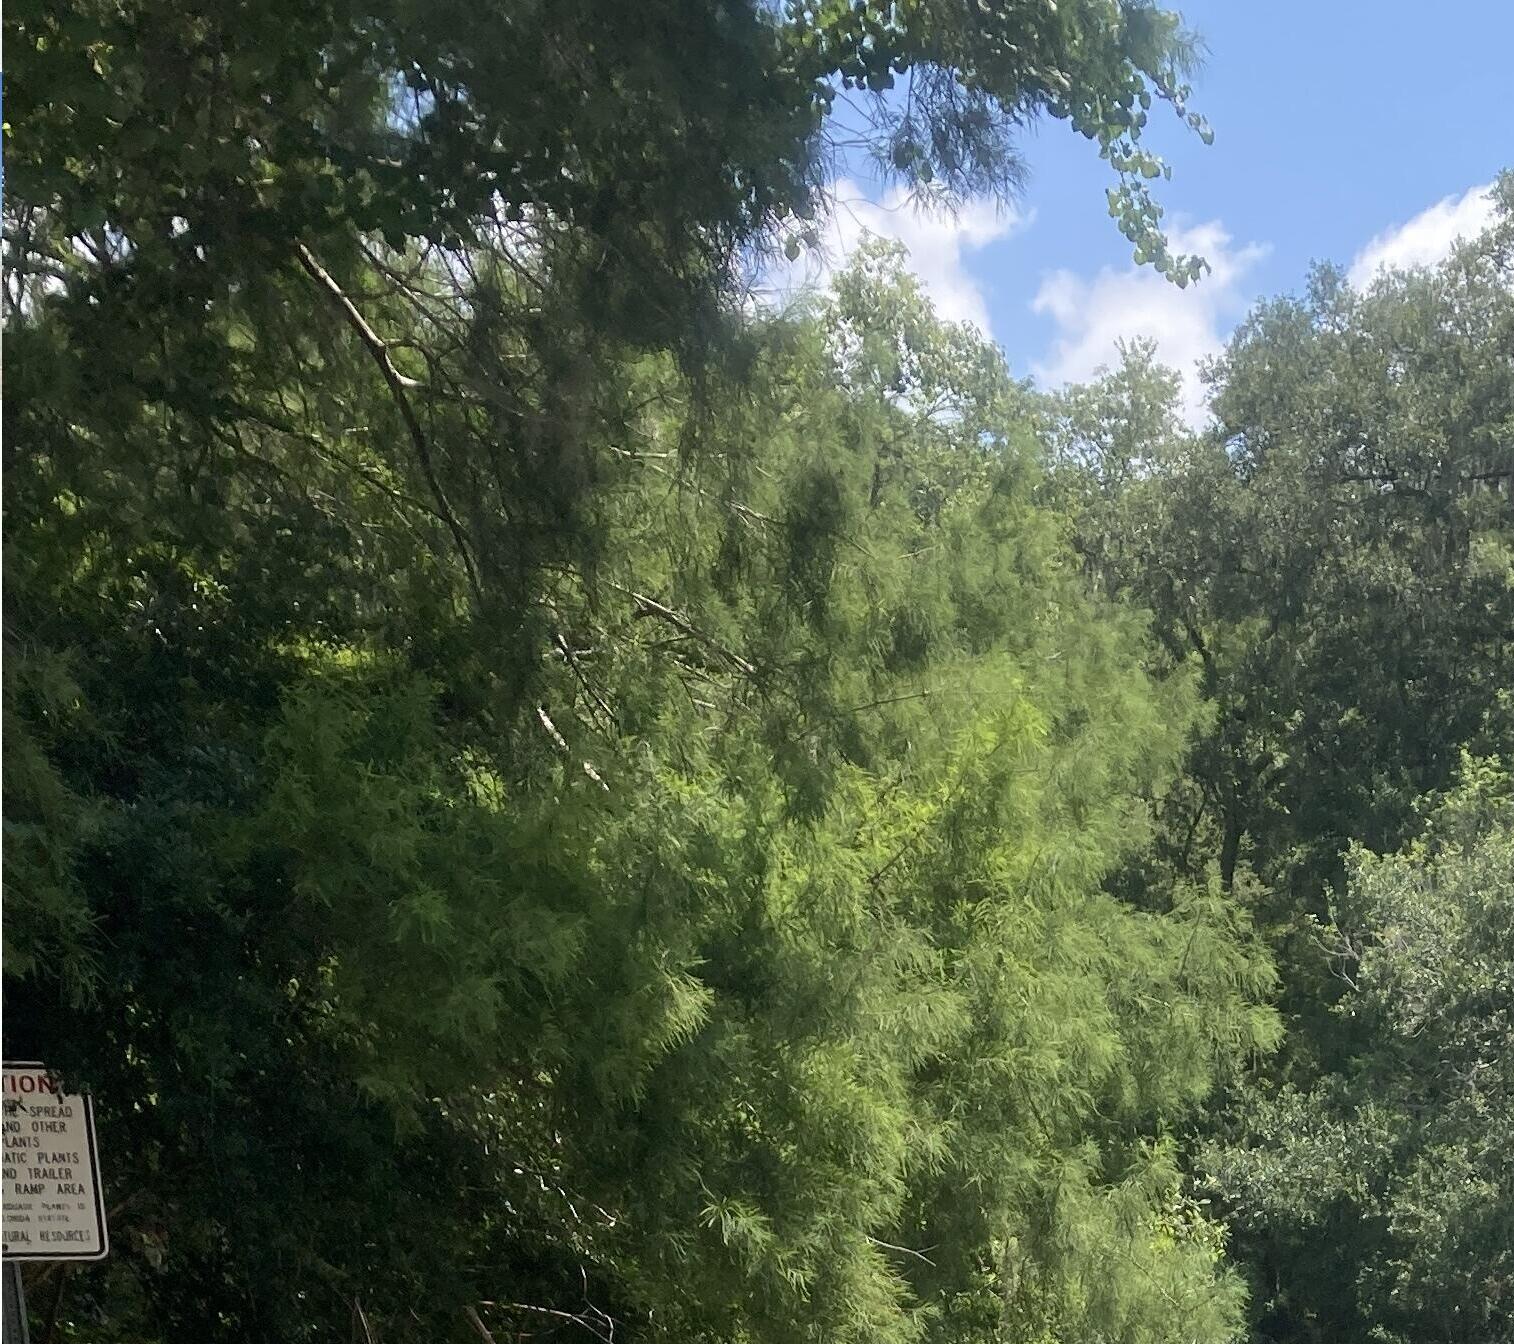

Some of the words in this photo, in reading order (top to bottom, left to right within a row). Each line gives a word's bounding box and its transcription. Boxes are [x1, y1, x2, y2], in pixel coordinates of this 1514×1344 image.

[29, 1106, 73, 1118] SPREAD
[31, 1121, 67, 1133] OTHER
[2, 1136, 40, 1148] LANTS
[37, 1152, 79, 1164] PLANTS
[28, 1167, 73, 1179] TRAILER
[15, 1183, 45, 1195] RAMP
[57, 1183, 86, 1195] AREA
